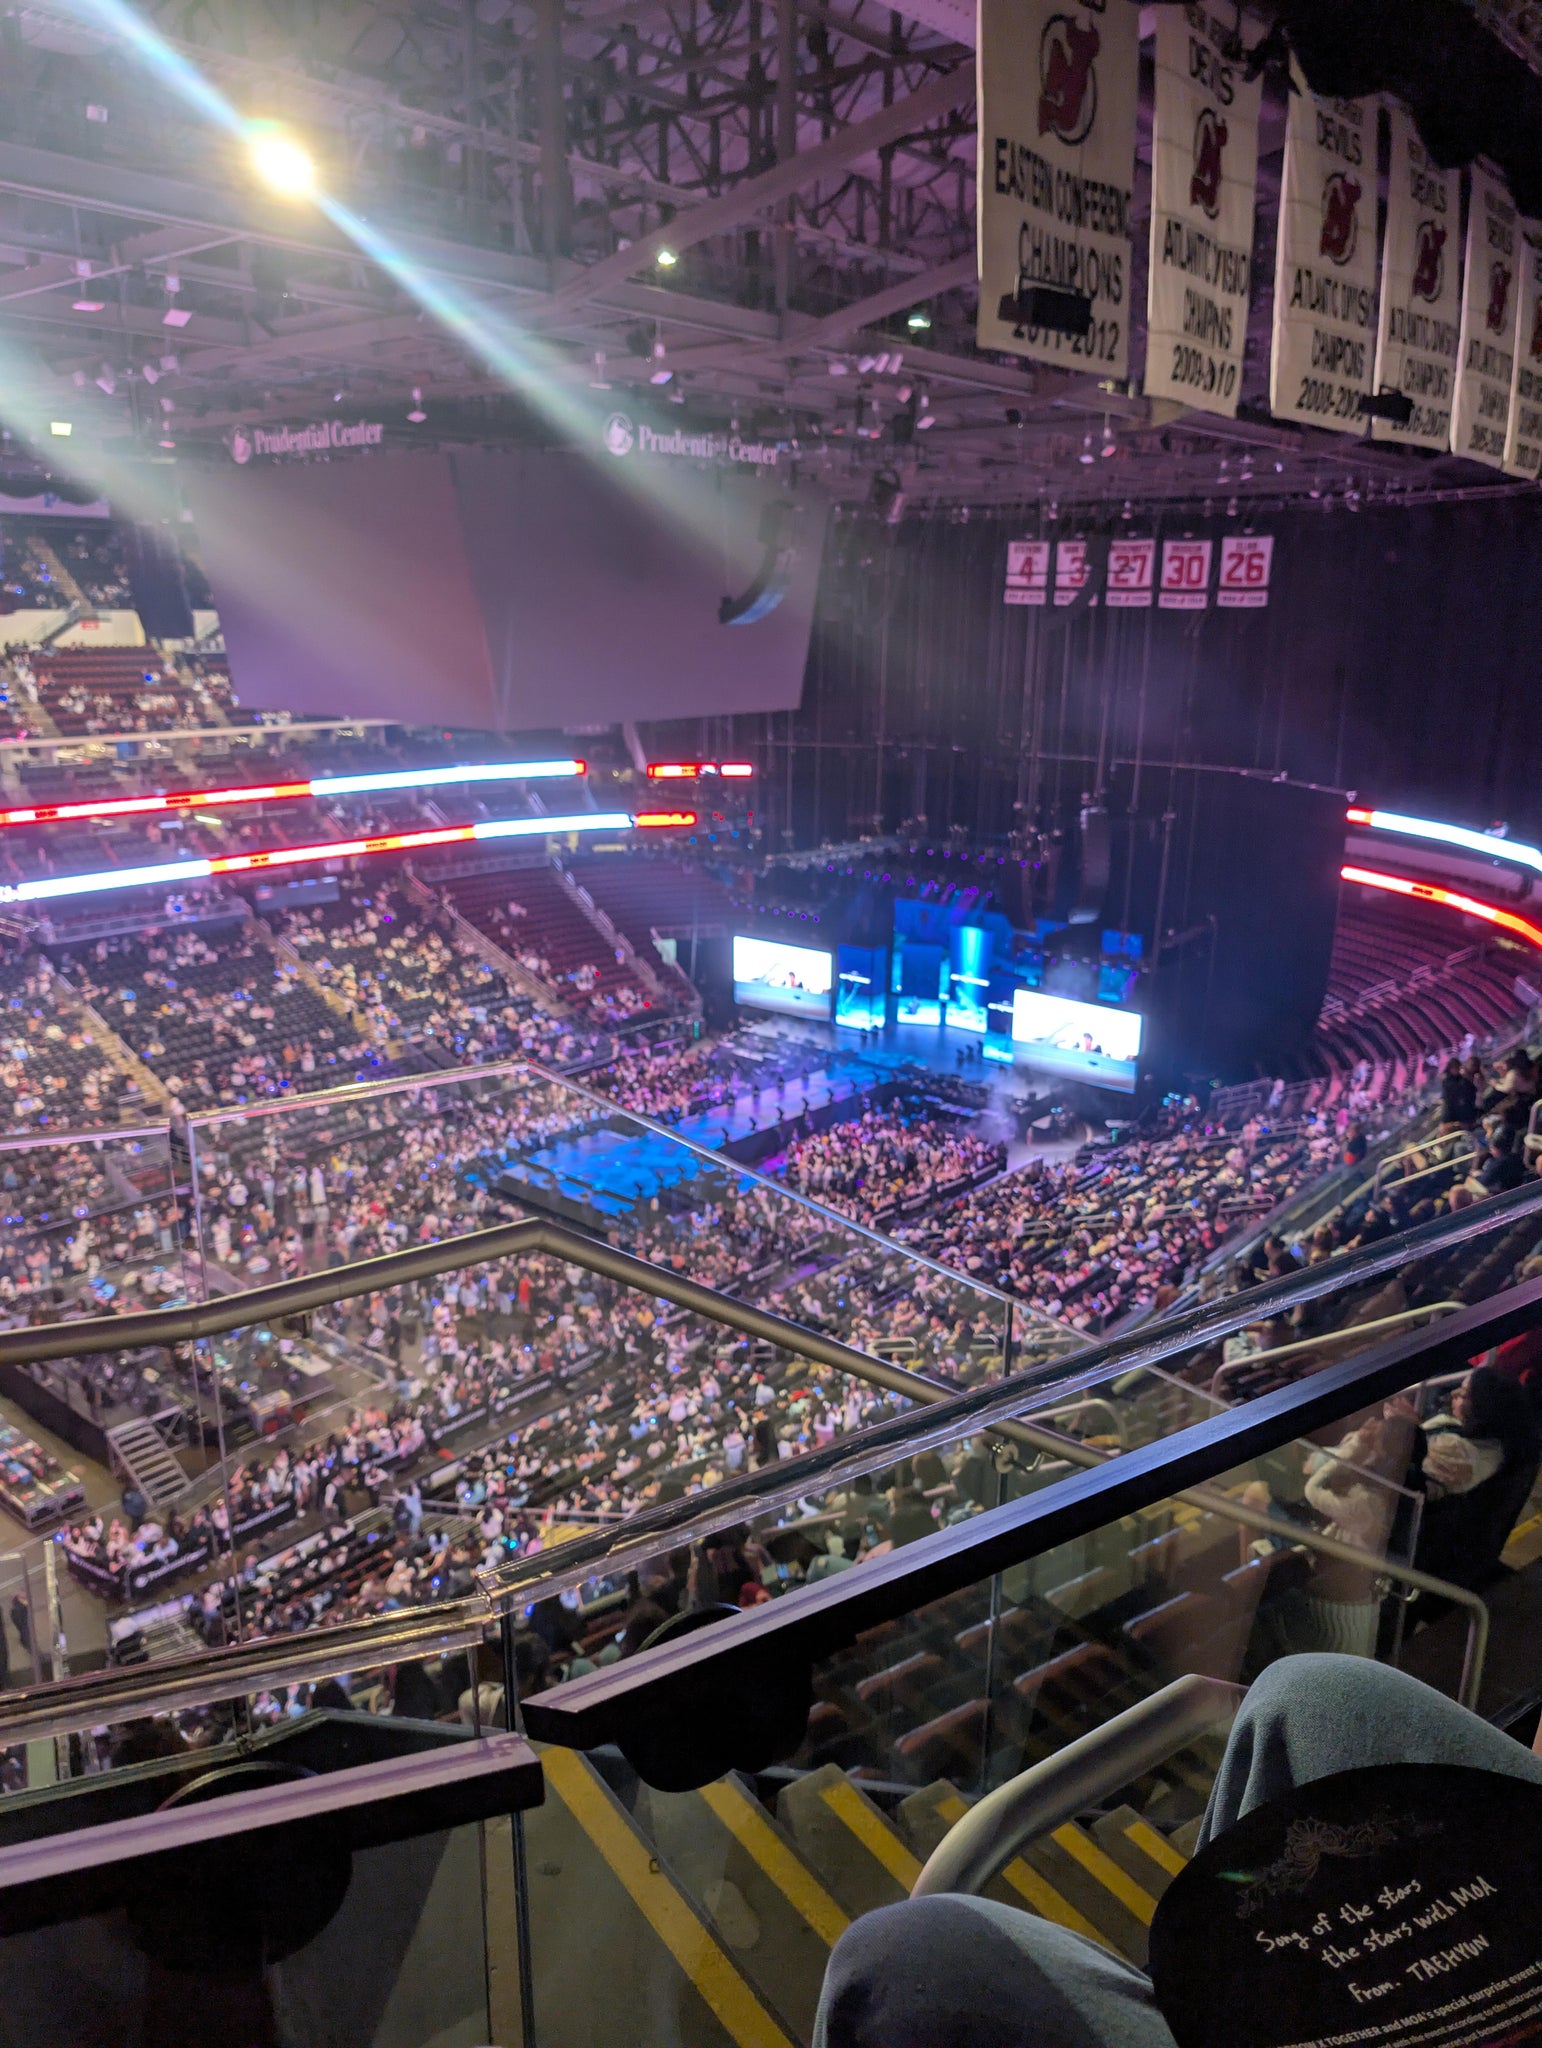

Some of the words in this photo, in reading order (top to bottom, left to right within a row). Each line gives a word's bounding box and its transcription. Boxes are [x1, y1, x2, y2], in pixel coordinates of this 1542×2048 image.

[1019, 221, 1123, 305] CHAMPIONS
[253, 420, 331, 455] Prudential
[331, 420, 383, 448] Center
[638, 424, 728, 459] Prudential
[729, 433, 777, 466] Center
[1020, 556, 1034, 587] 4
[1069, 557, 1085, 587] 3
[1114, 554, 1148, 585] 27
[1167, 555, 1204, 586] 30
[1226, 552, 1265, 583] 26
[1256, 1930, 1310, 1952] Song
[1312, 1912, 1332, 1935] of
[1339, 1902, 1374, 1925] the
[1377, 1879, 1421, 1910] stars
[1321, 1944, 1360, 1969] the
[1362, 1921, 1413, 1952] stars
[1412, 1899, 1457, 1929] with
[1450, 1875, 1498, 1908] MOA
[1405, 1933, 1490, 1981] TAEHYUN
[1324, 2026, 1381, 2047] TOGETHER
[1381, 2019, 1401, 2034] and
[1400, 2010, 1435, 2029] MOA's
[1433, 1995, 1471, 2017] special
[1468, 1980, 1510, 2003] surprise
[1508, 1965, 1539, 1984] event
